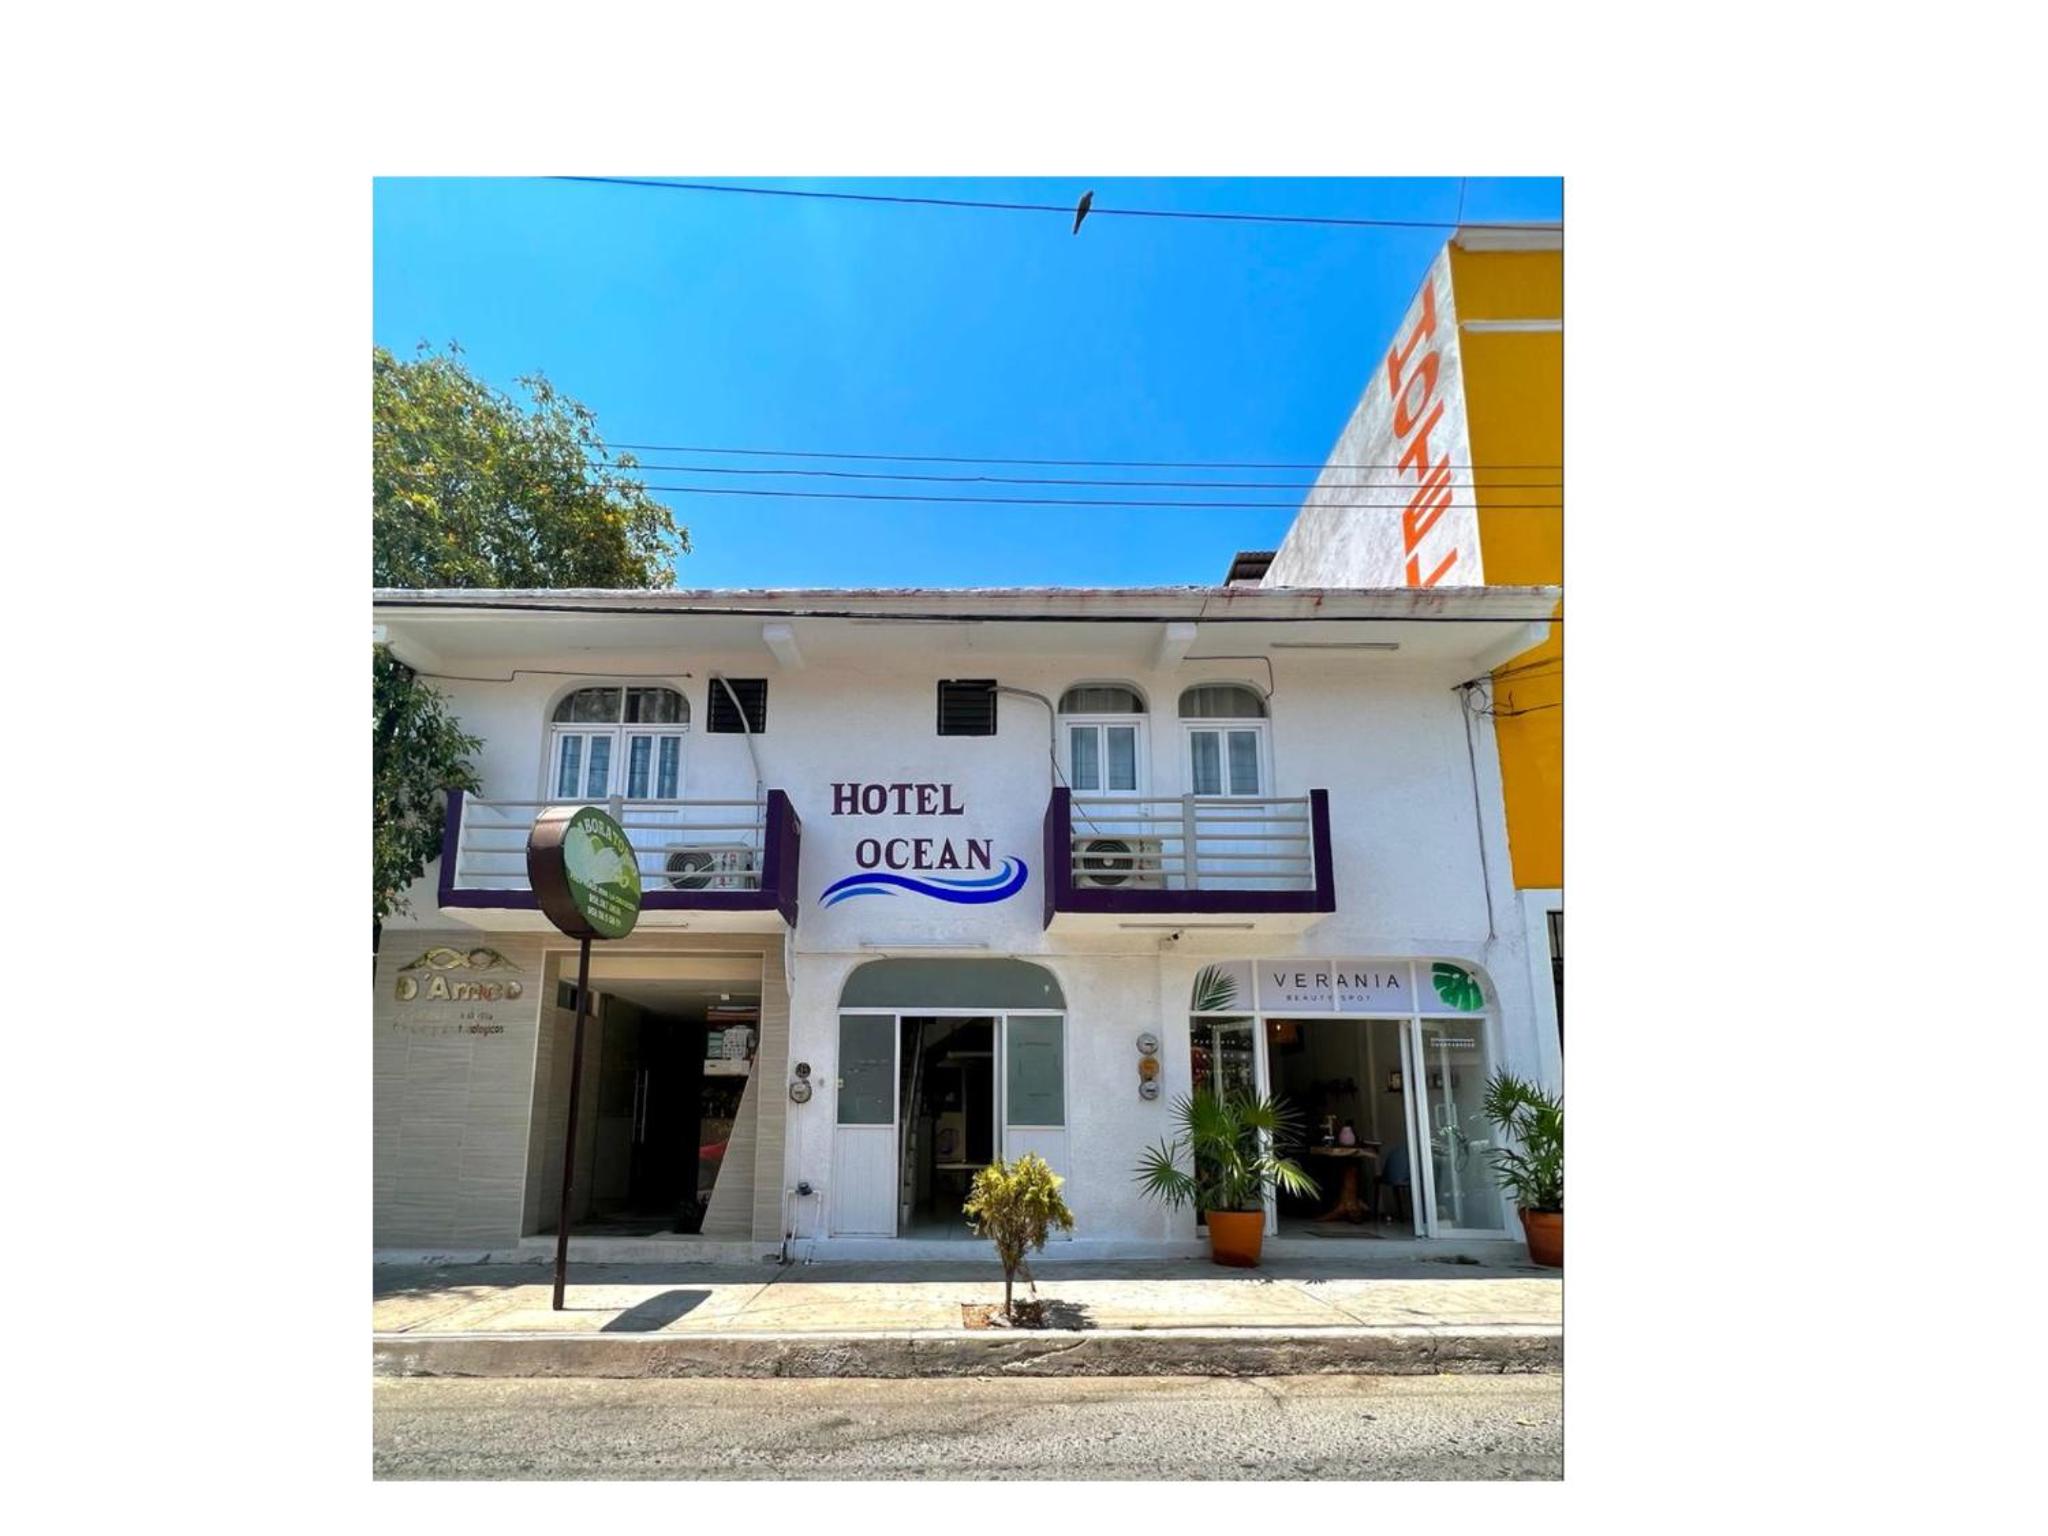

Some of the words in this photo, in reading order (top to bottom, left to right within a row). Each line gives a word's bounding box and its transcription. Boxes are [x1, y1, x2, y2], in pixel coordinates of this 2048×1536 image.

[1387, 276, 1458, 587] HOTEL
[830, 783, 964, 816] HOTEL
[855, 837, 993, 870] OCEAN
[1273, 973, 1400, 989] VERANIA
